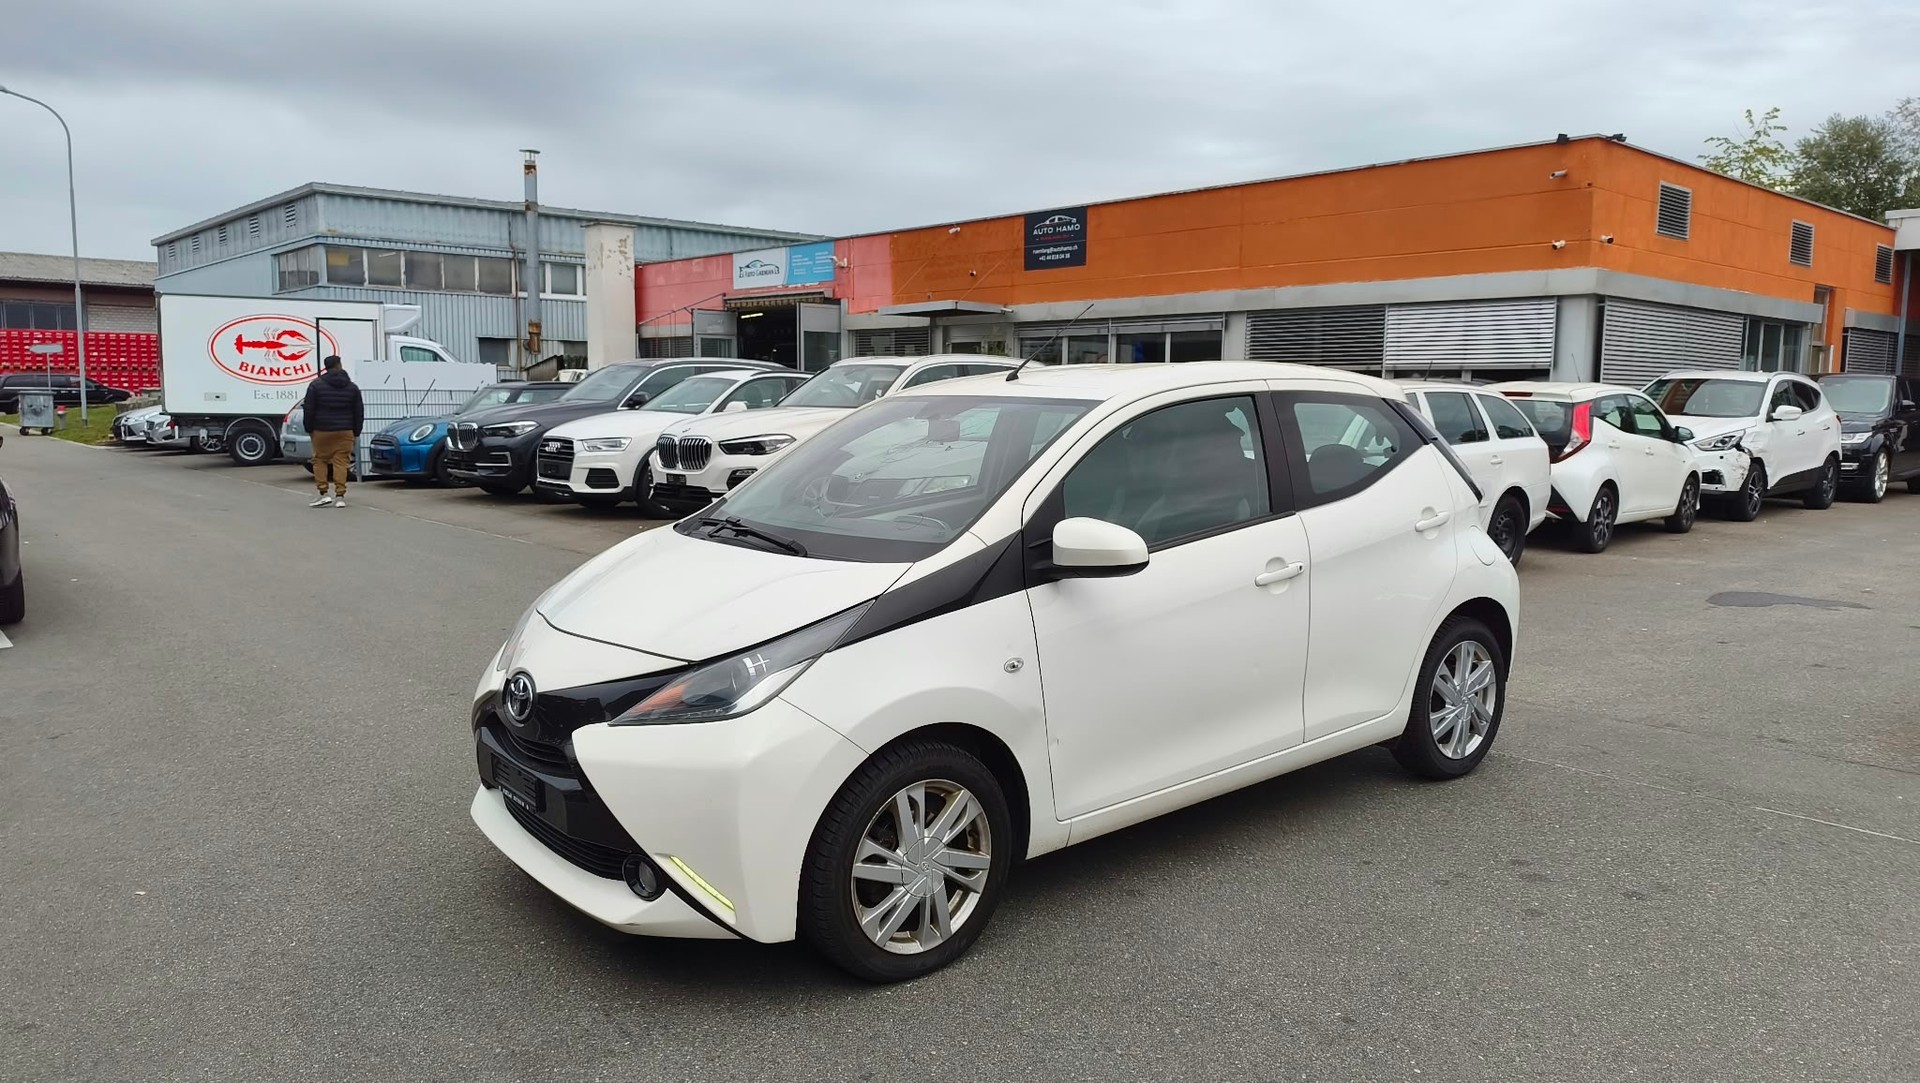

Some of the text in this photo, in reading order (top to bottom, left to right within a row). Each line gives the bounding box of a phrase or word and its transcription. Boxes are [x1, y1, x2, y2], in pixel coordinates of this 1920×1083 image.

[1033, 223, 1081, 235] AUTO HAMO
[239, 361, 312, 377] BIANCHI
[253, 389, 299, 400] Est. 1881
